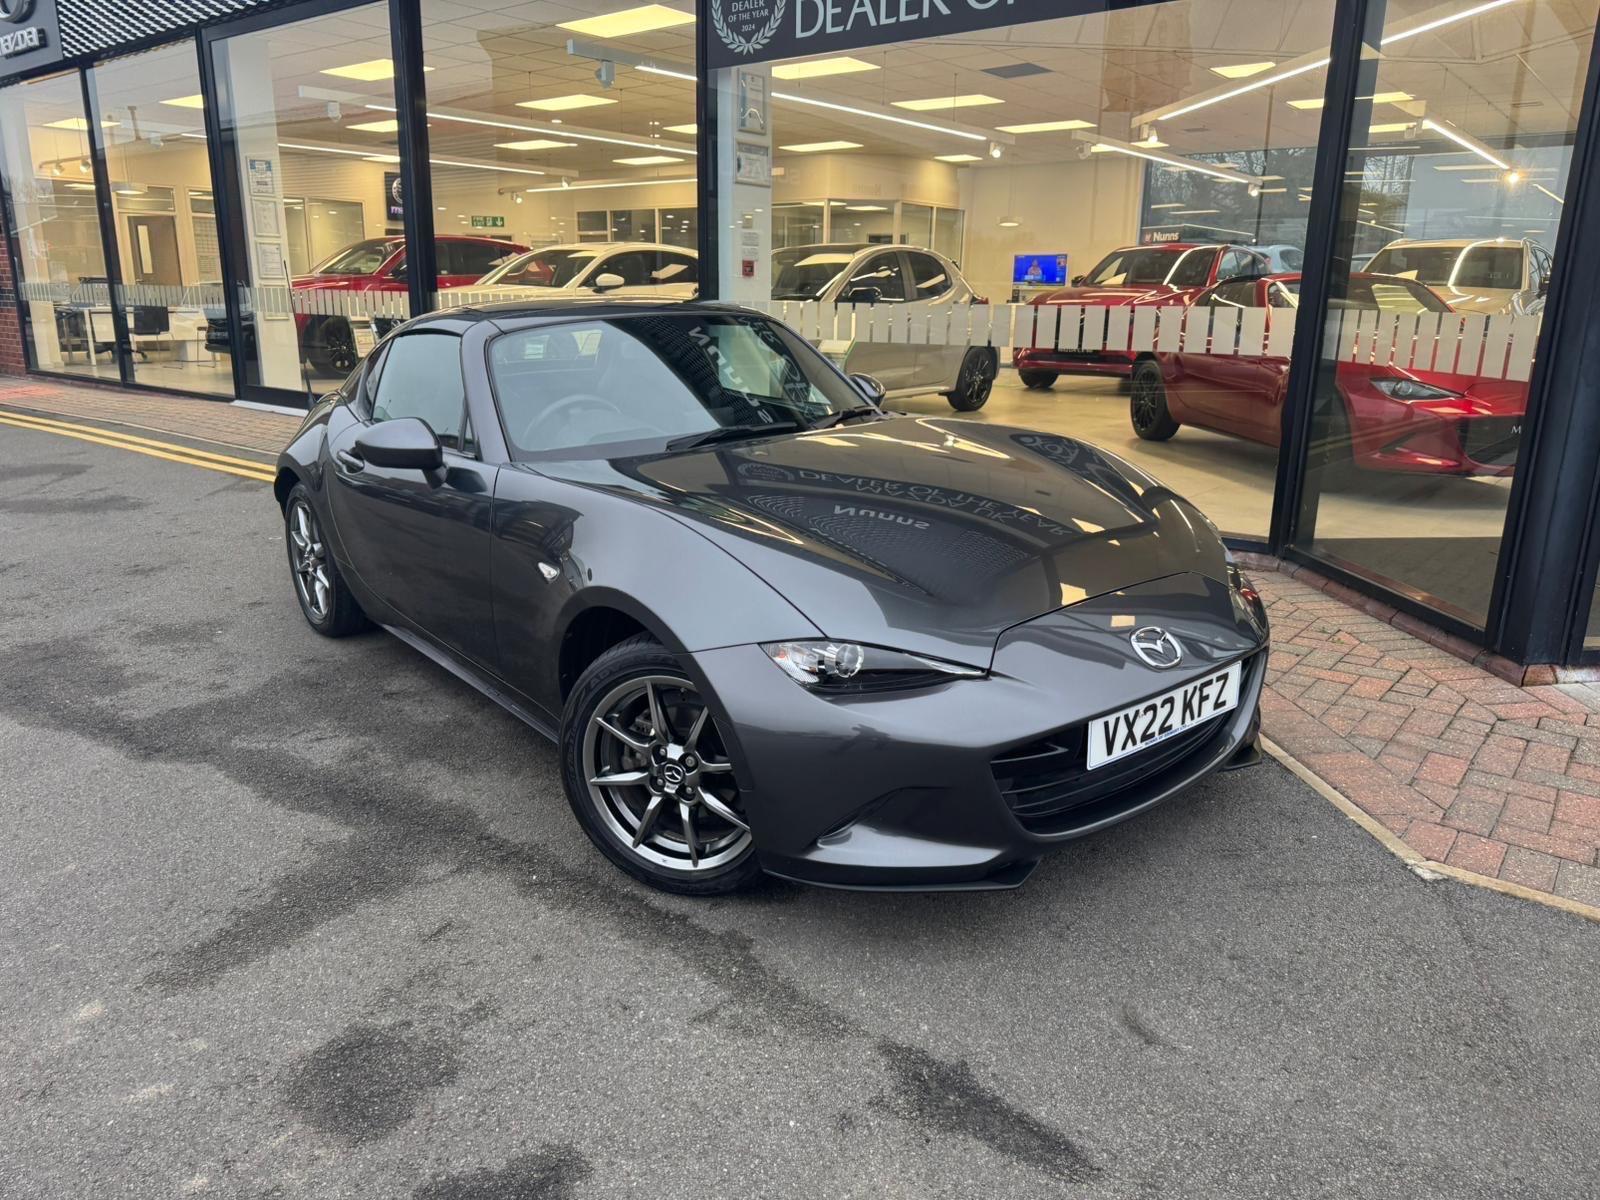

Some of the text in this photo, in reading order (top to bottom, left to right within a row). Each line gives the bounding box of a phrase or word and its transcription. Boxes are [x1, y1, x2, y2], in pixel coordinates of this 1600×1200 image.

[732, 0, 765, 12] DEALER
[728, 8, 769, 23] OF THE YEAR
[741, 23, 756, 32] 2024
[0, 27, 40, 56] azda
[1152, 231, 1180, 242] Nunns
[1103, 671, 1230, 757] VX22 KFZ
